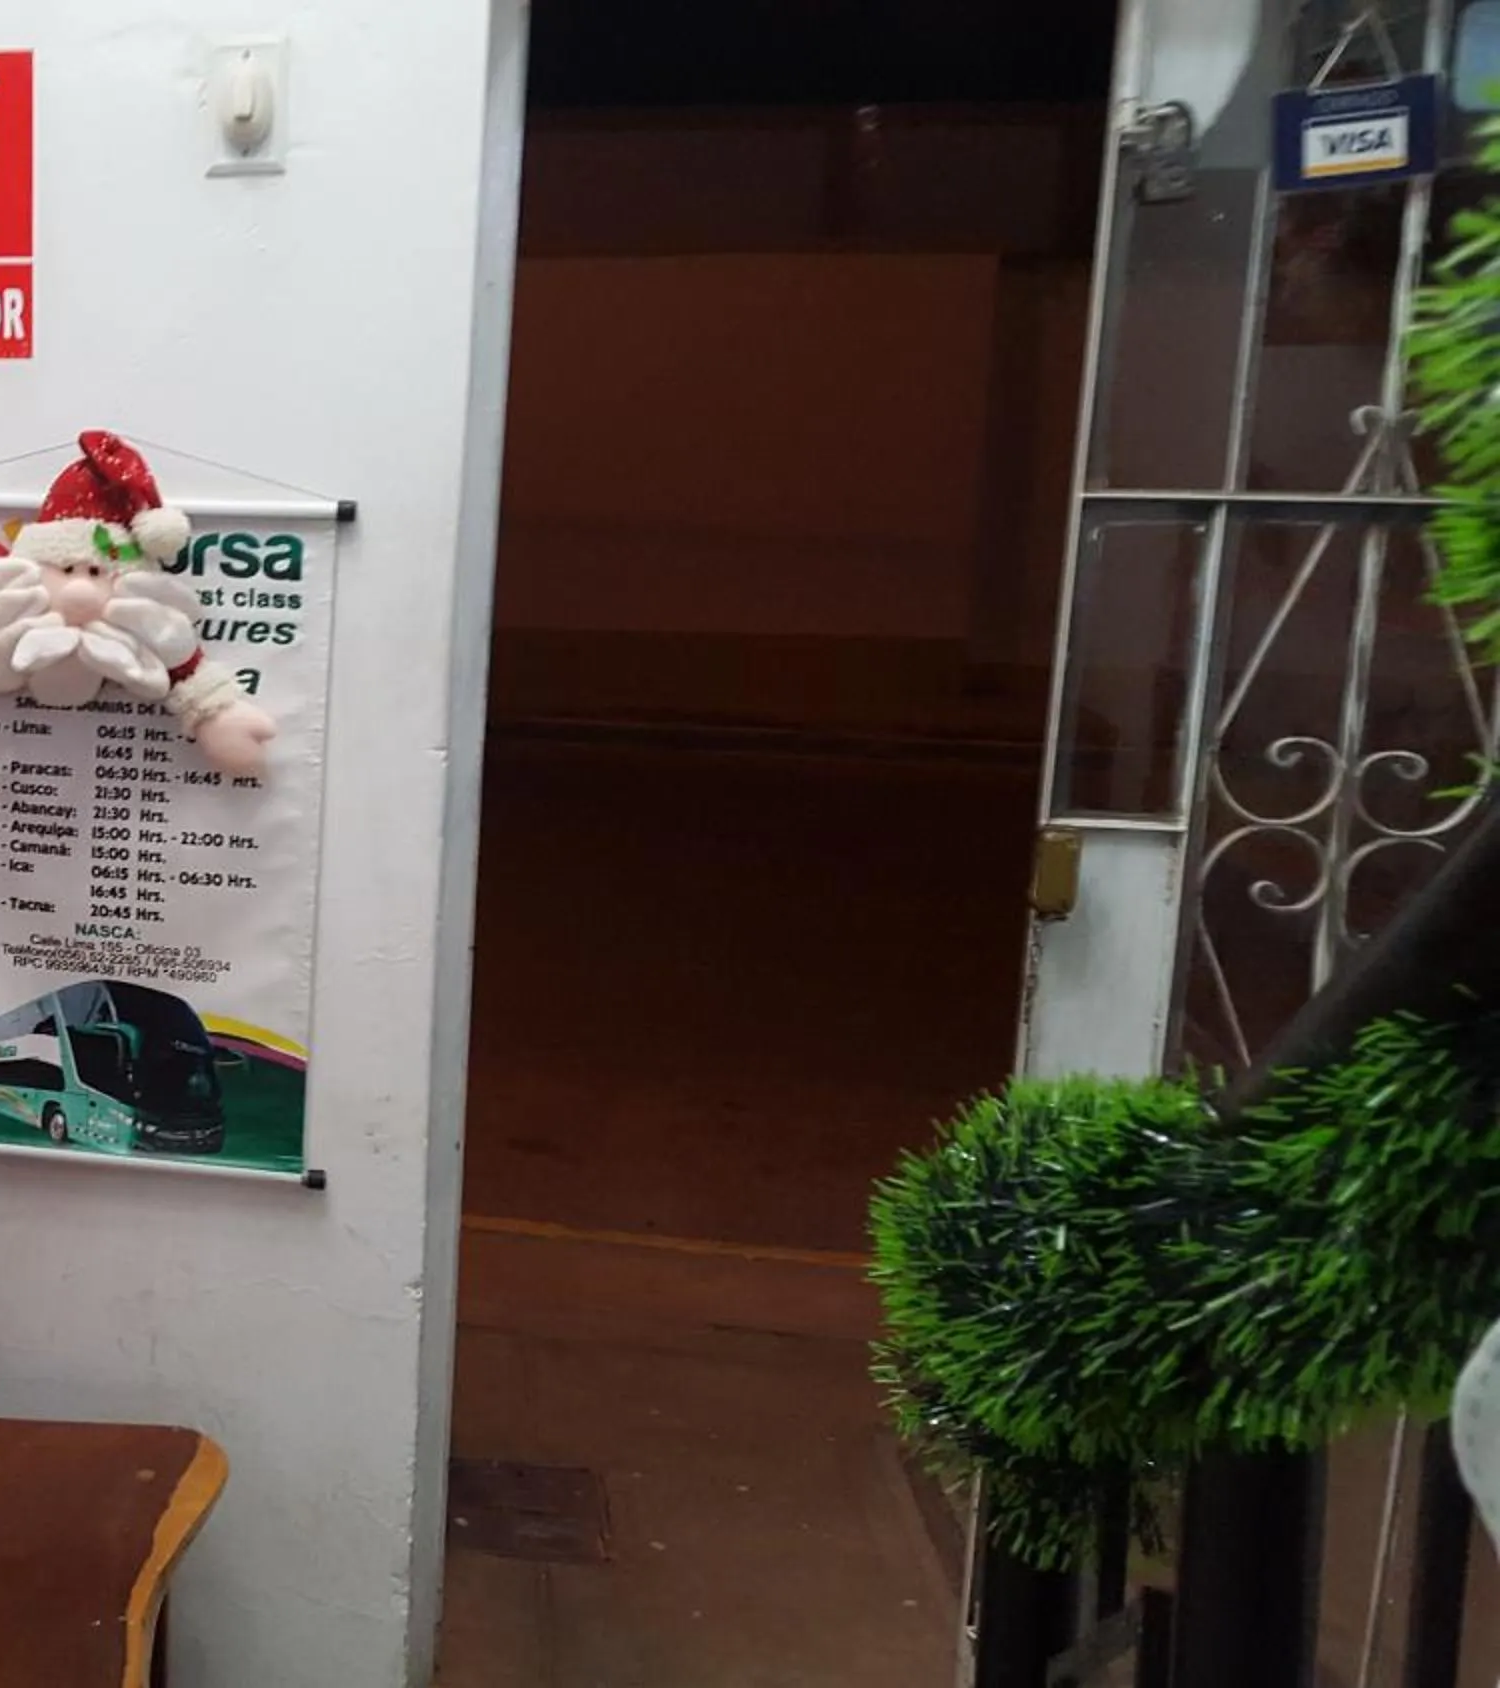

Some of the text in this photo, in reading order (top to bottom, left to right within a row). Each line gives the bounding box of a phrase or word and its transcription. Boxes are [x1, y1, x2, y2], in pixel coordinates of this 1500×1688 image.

[1321, 127, 1393, 155] VISA
[233, 587, 302, 610] class
[96, 725, 136, 740] 06:15
[95, 745, 133, 761] 16:45
[94, 765, 139, 781] 06:30
[183, 770, 222, 787] 16:45
[94, 785, 131, 801] 21:30
[93, 805, 131, 821] 21:30
[91, 825, 131, 841] 15:00
[180, 831, 225, 848] 22:00
[91, 845, 130, 861] 15:00
[90, 864, 129, 881] 06:15
[178, 870, 224, 887] 06:30
[90, 884, 127, 900] 16:45
[89, 903, 132, 920] 20:45
[75, 922, 142, 940] NASCA:
